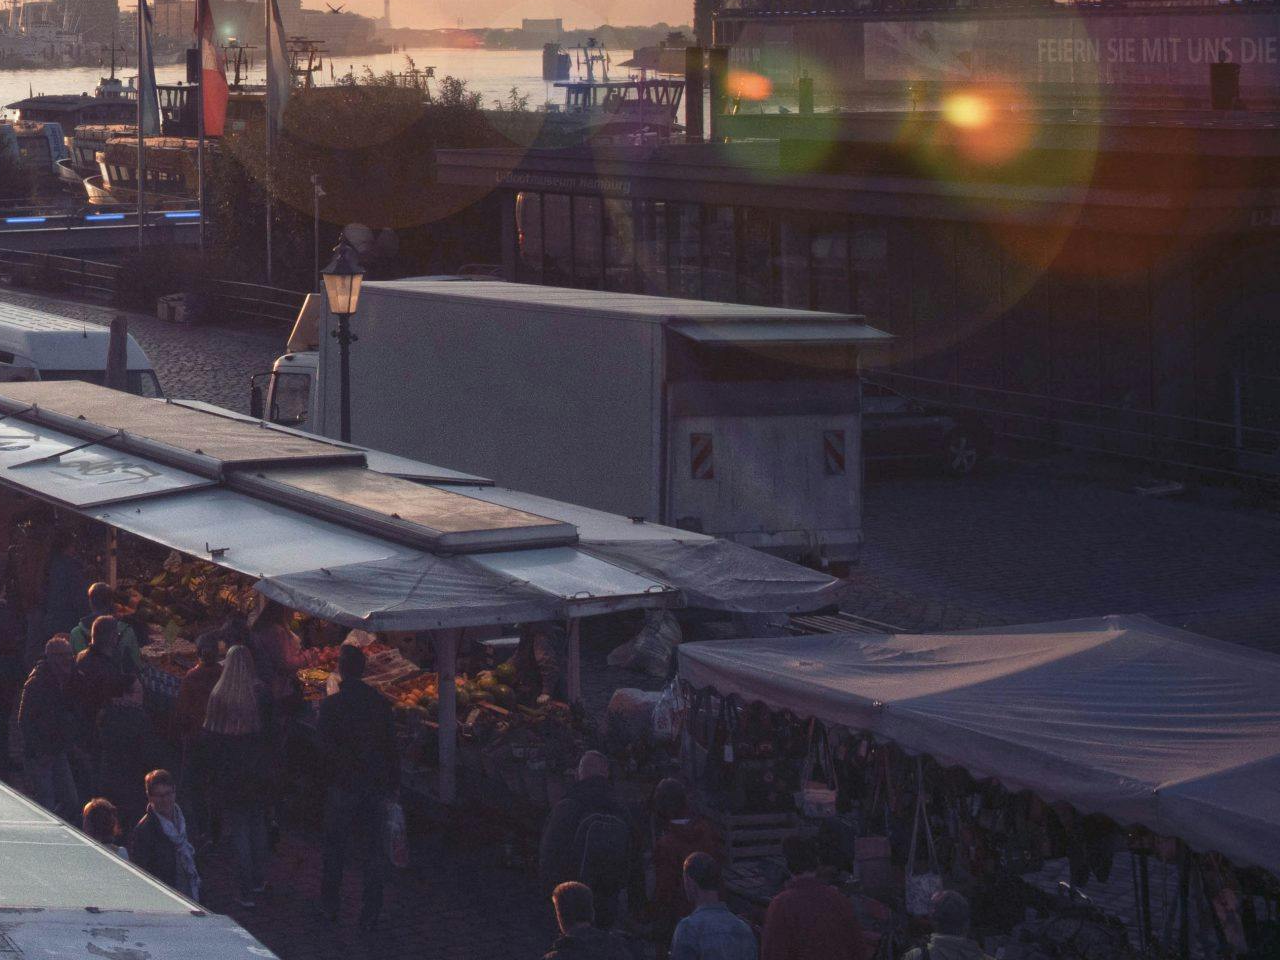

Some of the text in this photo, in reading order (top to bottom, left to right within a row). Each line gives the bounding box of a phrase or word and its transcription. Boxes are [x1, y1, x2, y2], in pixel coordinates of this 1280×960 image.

[1037, 36, 1277, 64] FEIERN SIE MIT UNS DIE
[579, 176, 632, 194] Hamburg
